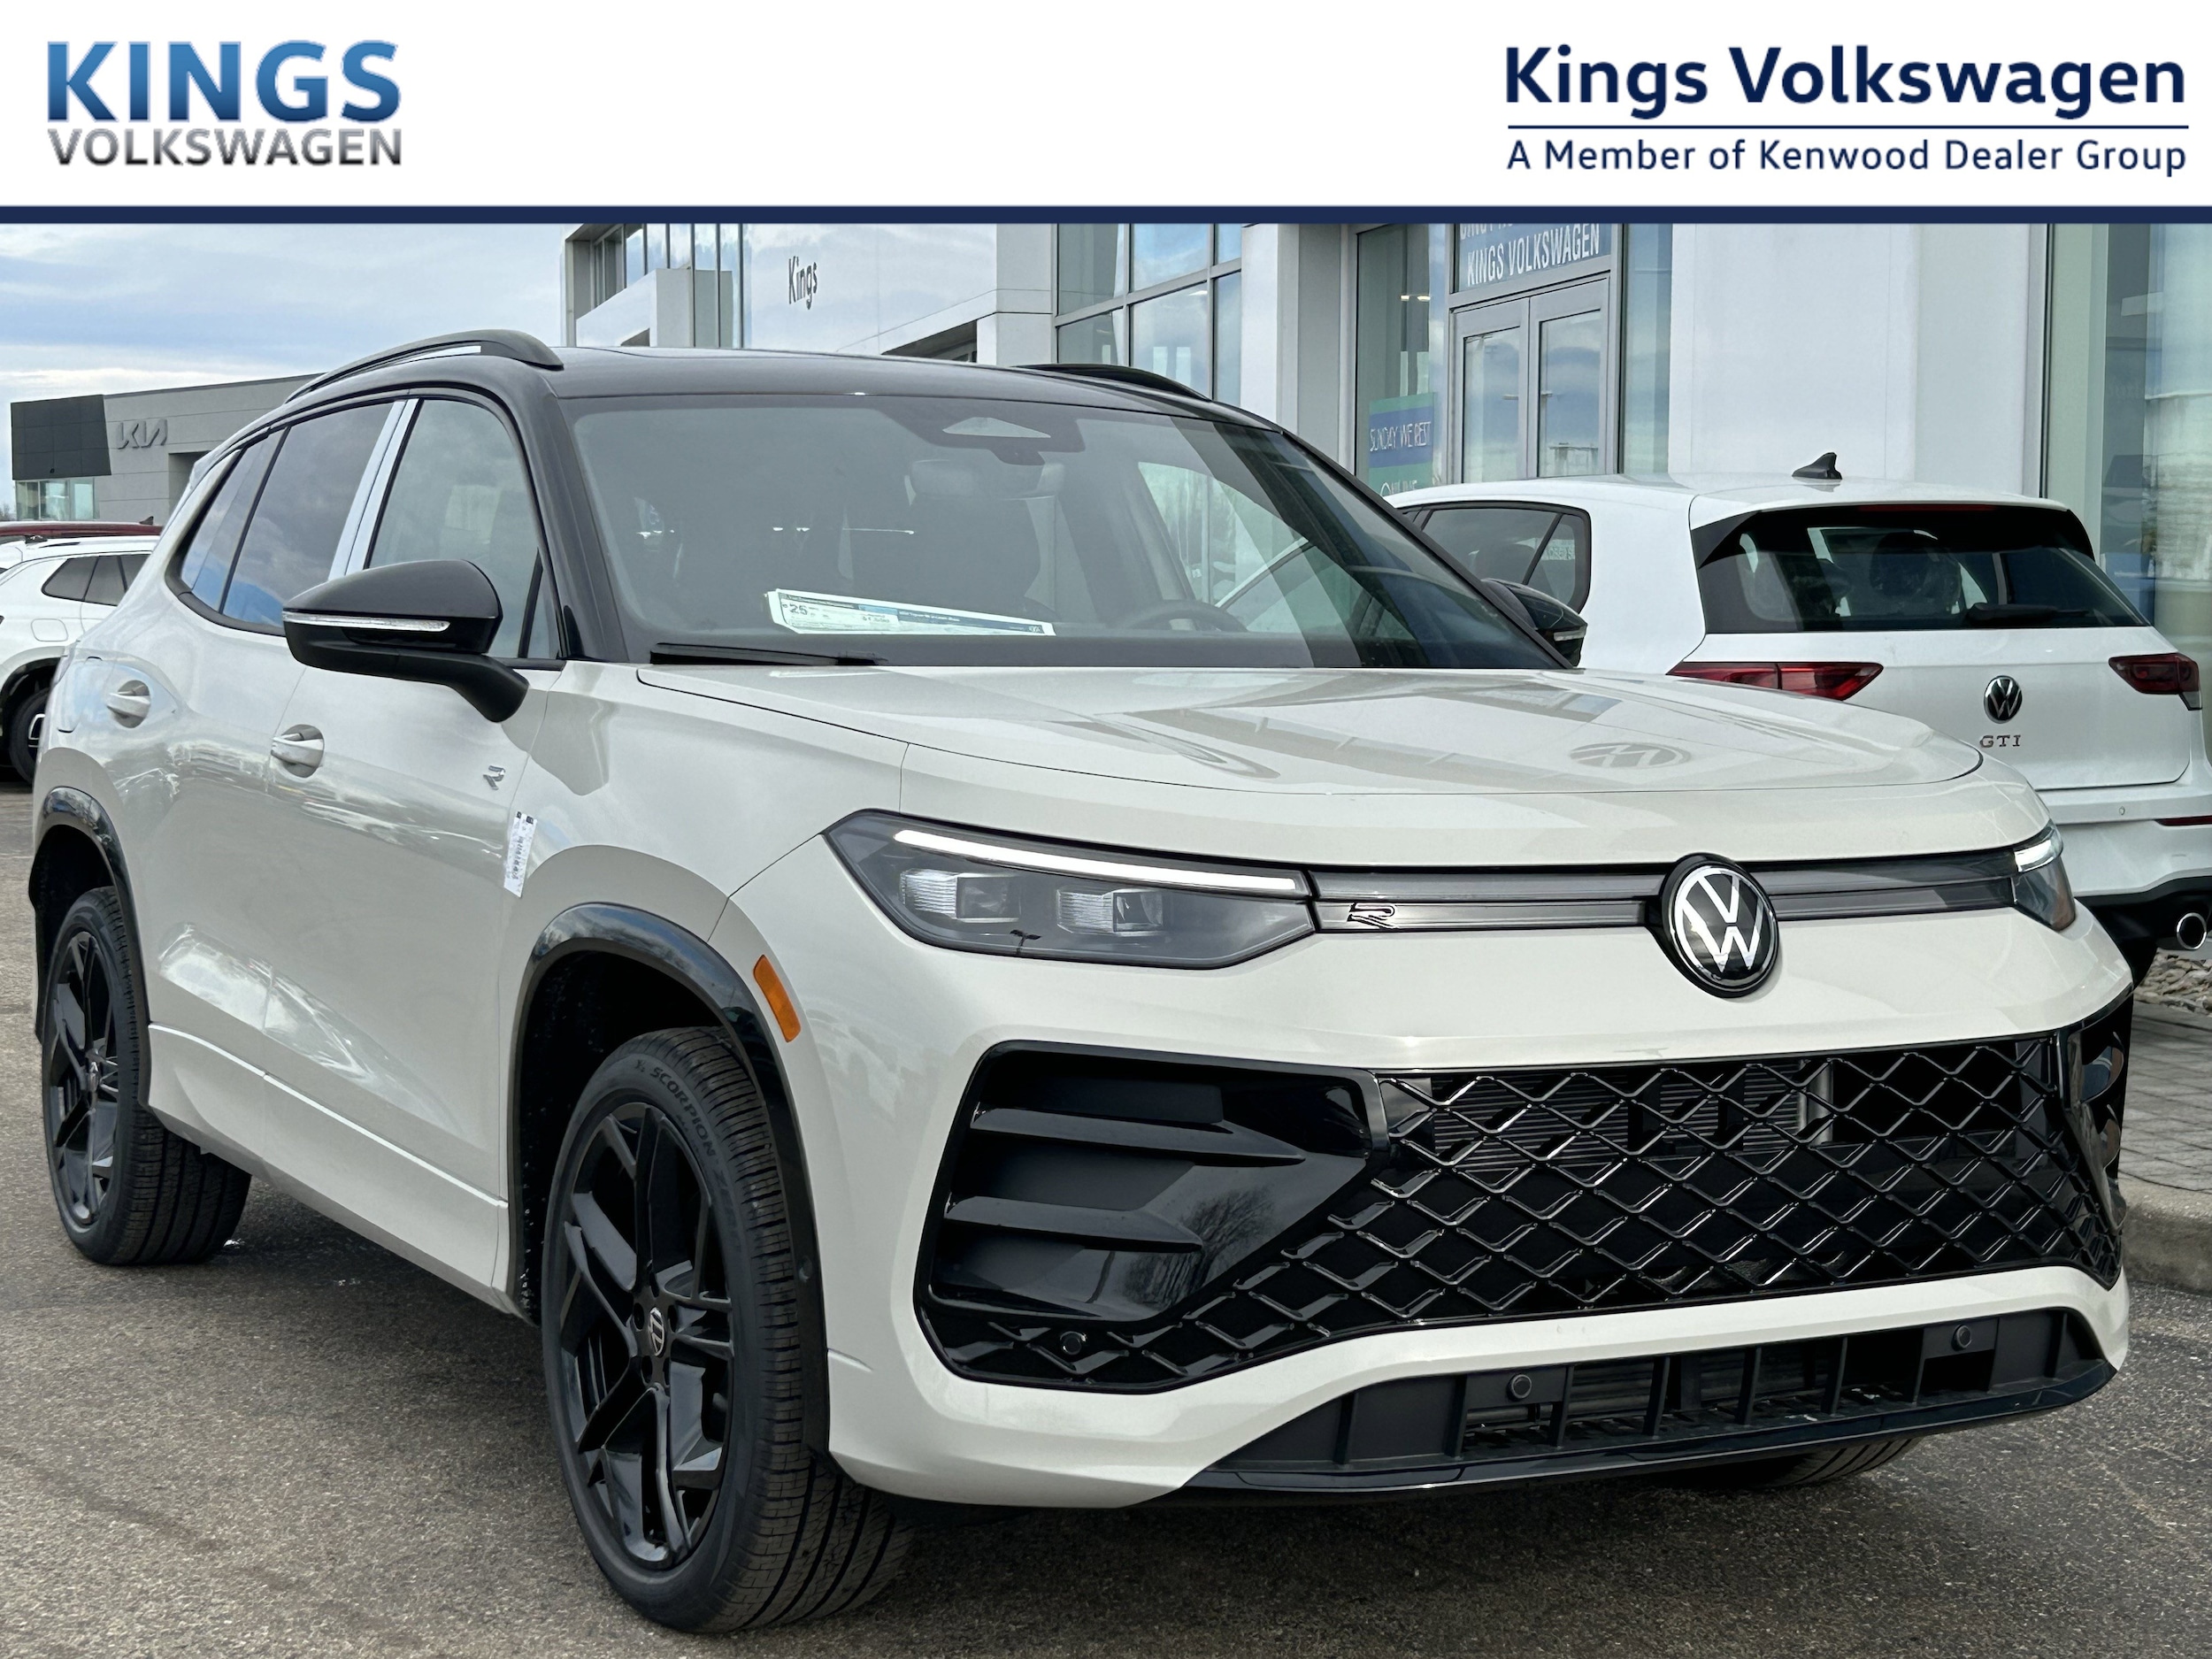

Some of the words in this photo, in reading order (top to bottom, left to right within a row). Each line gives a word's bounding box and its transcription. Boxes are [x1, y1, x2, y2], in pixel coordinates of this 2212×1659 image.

[788, 255, 818, 310] Kings
[1467, 242, 1504, 287] KINGS
[1508, 223, 1601, 276] VOLKSWAGEN
[1400, 423, 1414, 448] WE
[1979, 734, 2021, 749] GTI
[650, 1066, 718, 1158] SCORPION
